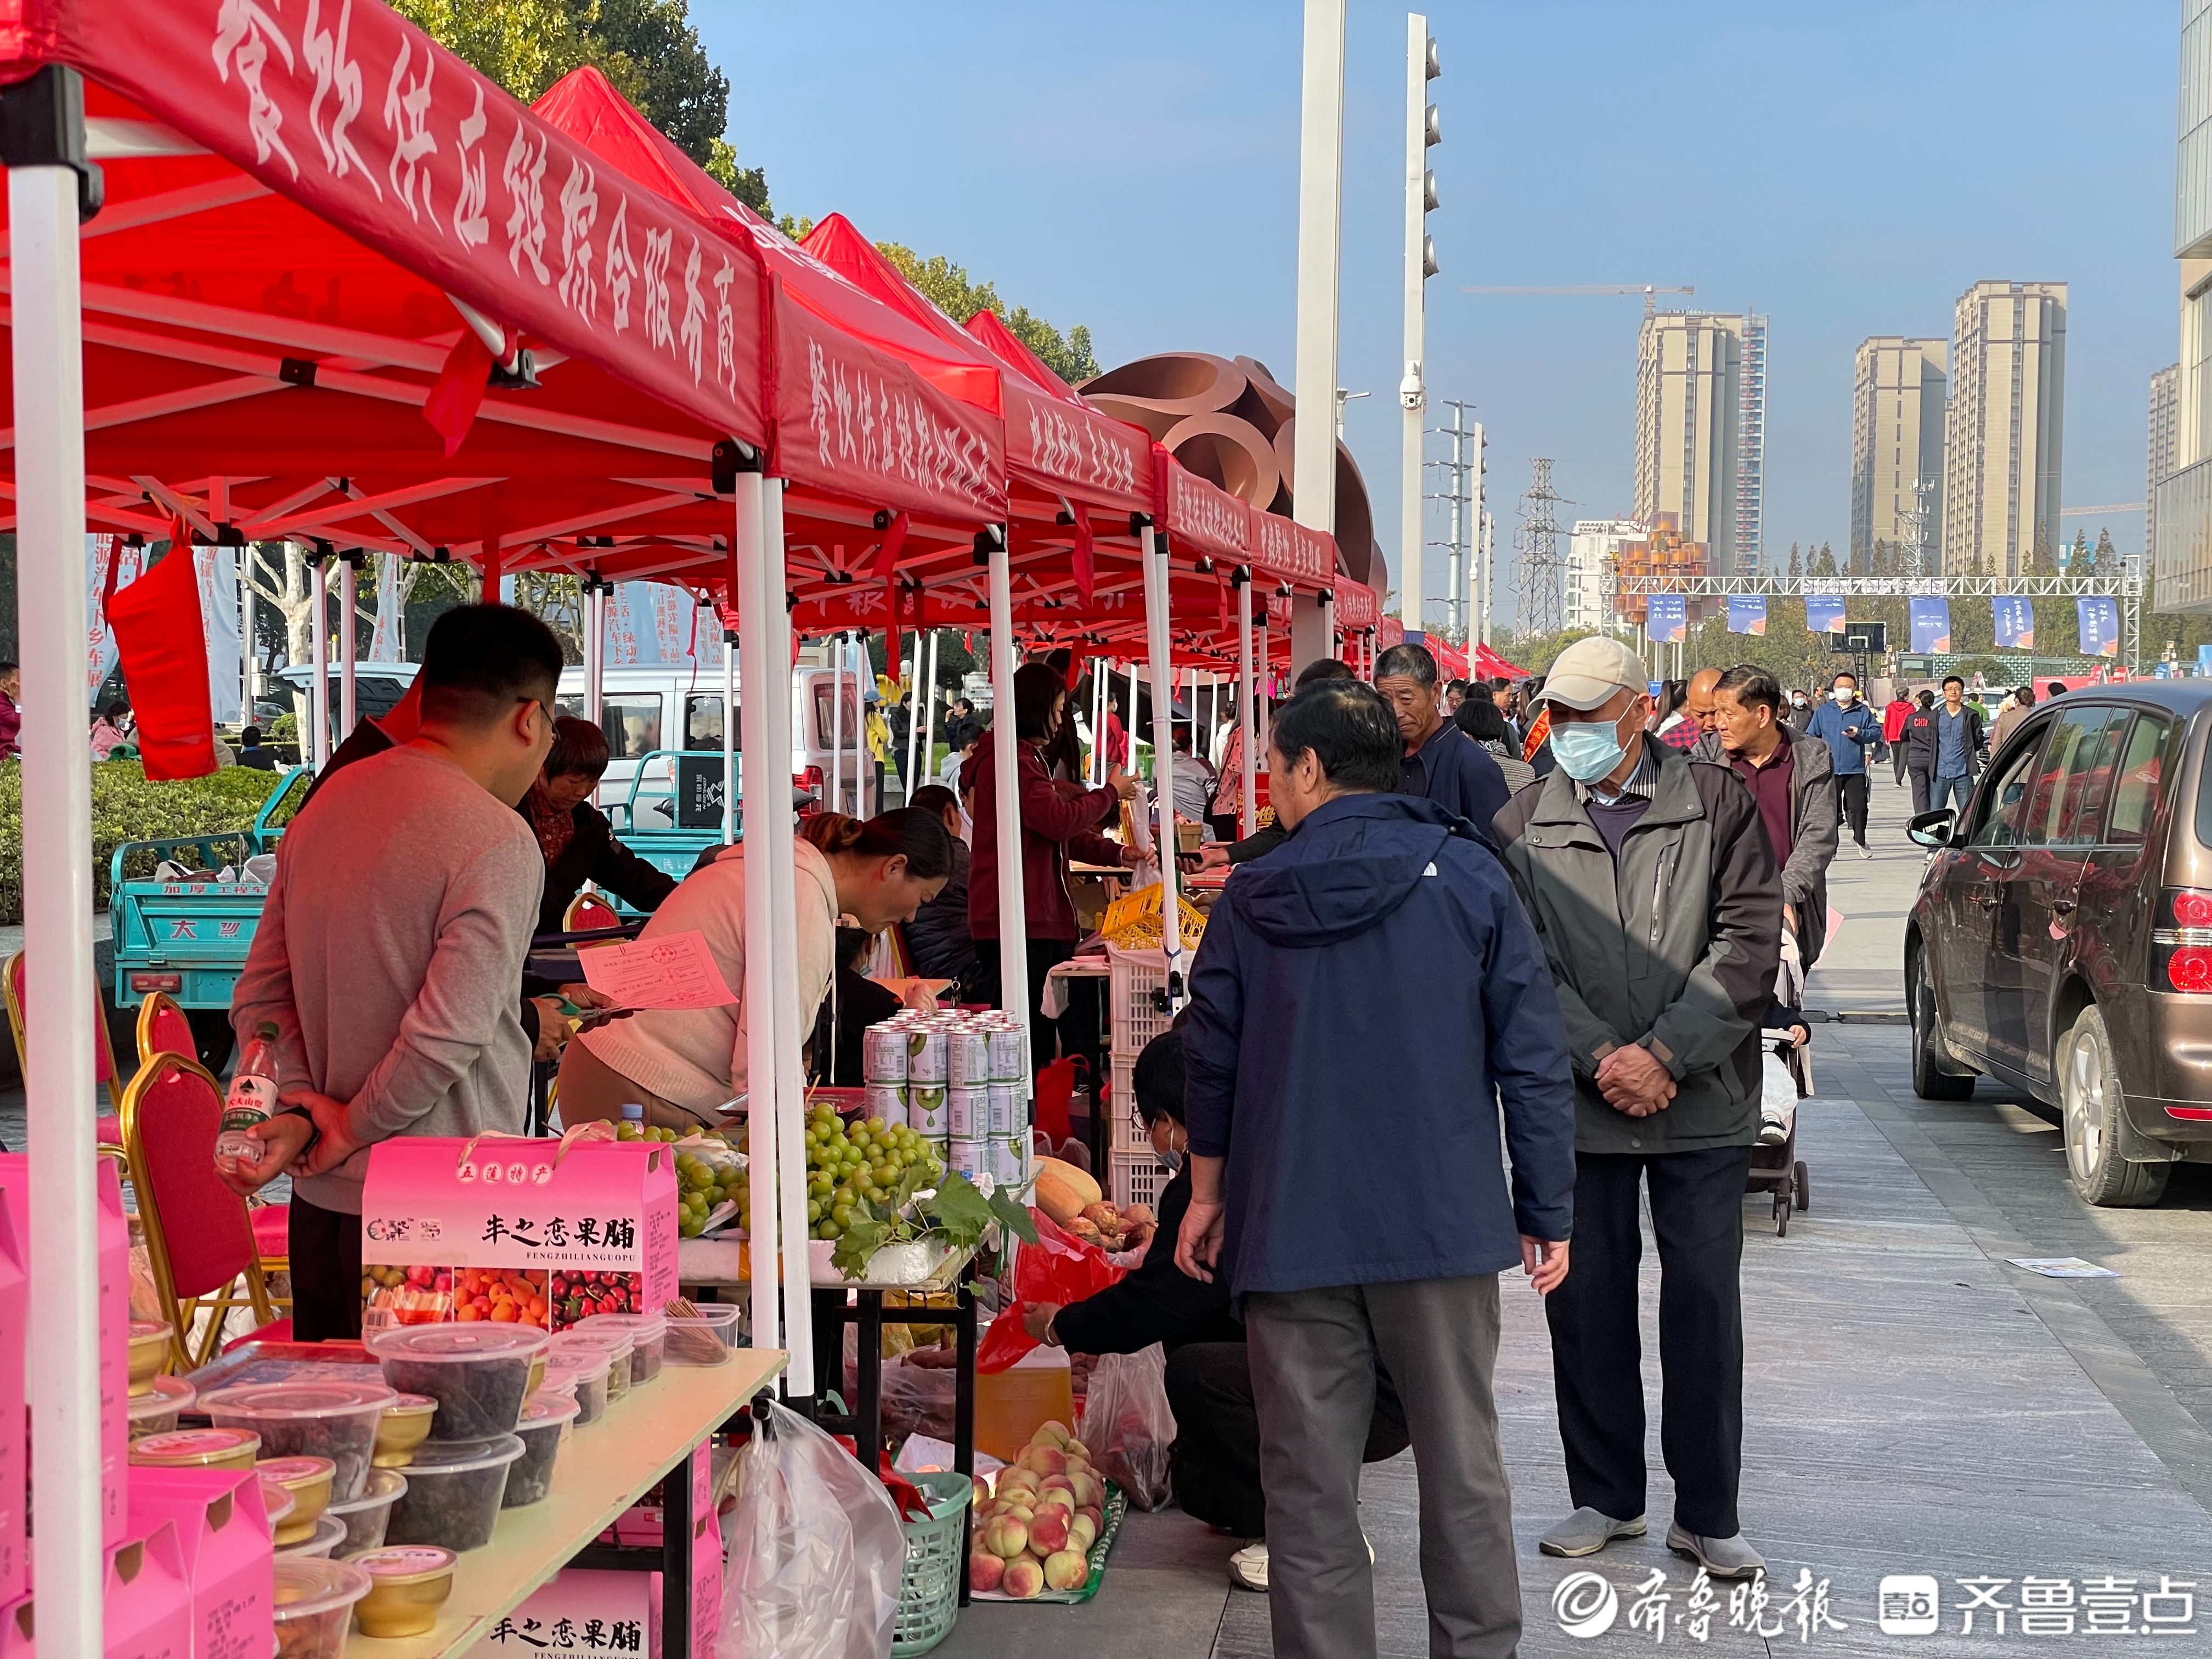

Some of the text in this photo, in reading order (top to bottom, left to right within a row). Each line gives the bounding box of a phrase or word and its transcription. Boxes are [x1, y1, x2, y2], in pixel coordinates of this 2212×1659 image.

[951, 1039, 963, 1086] FRUIT JUICE
[975, 1091, 986, 1139] FRUIT JUICE
[460, 1164, 551, 1184] 五莲特产
[482, 1214, 635, 1250] 丰之恋果脯
[526, 1251, 636, 1262] FENGZHILIANGUOPU
